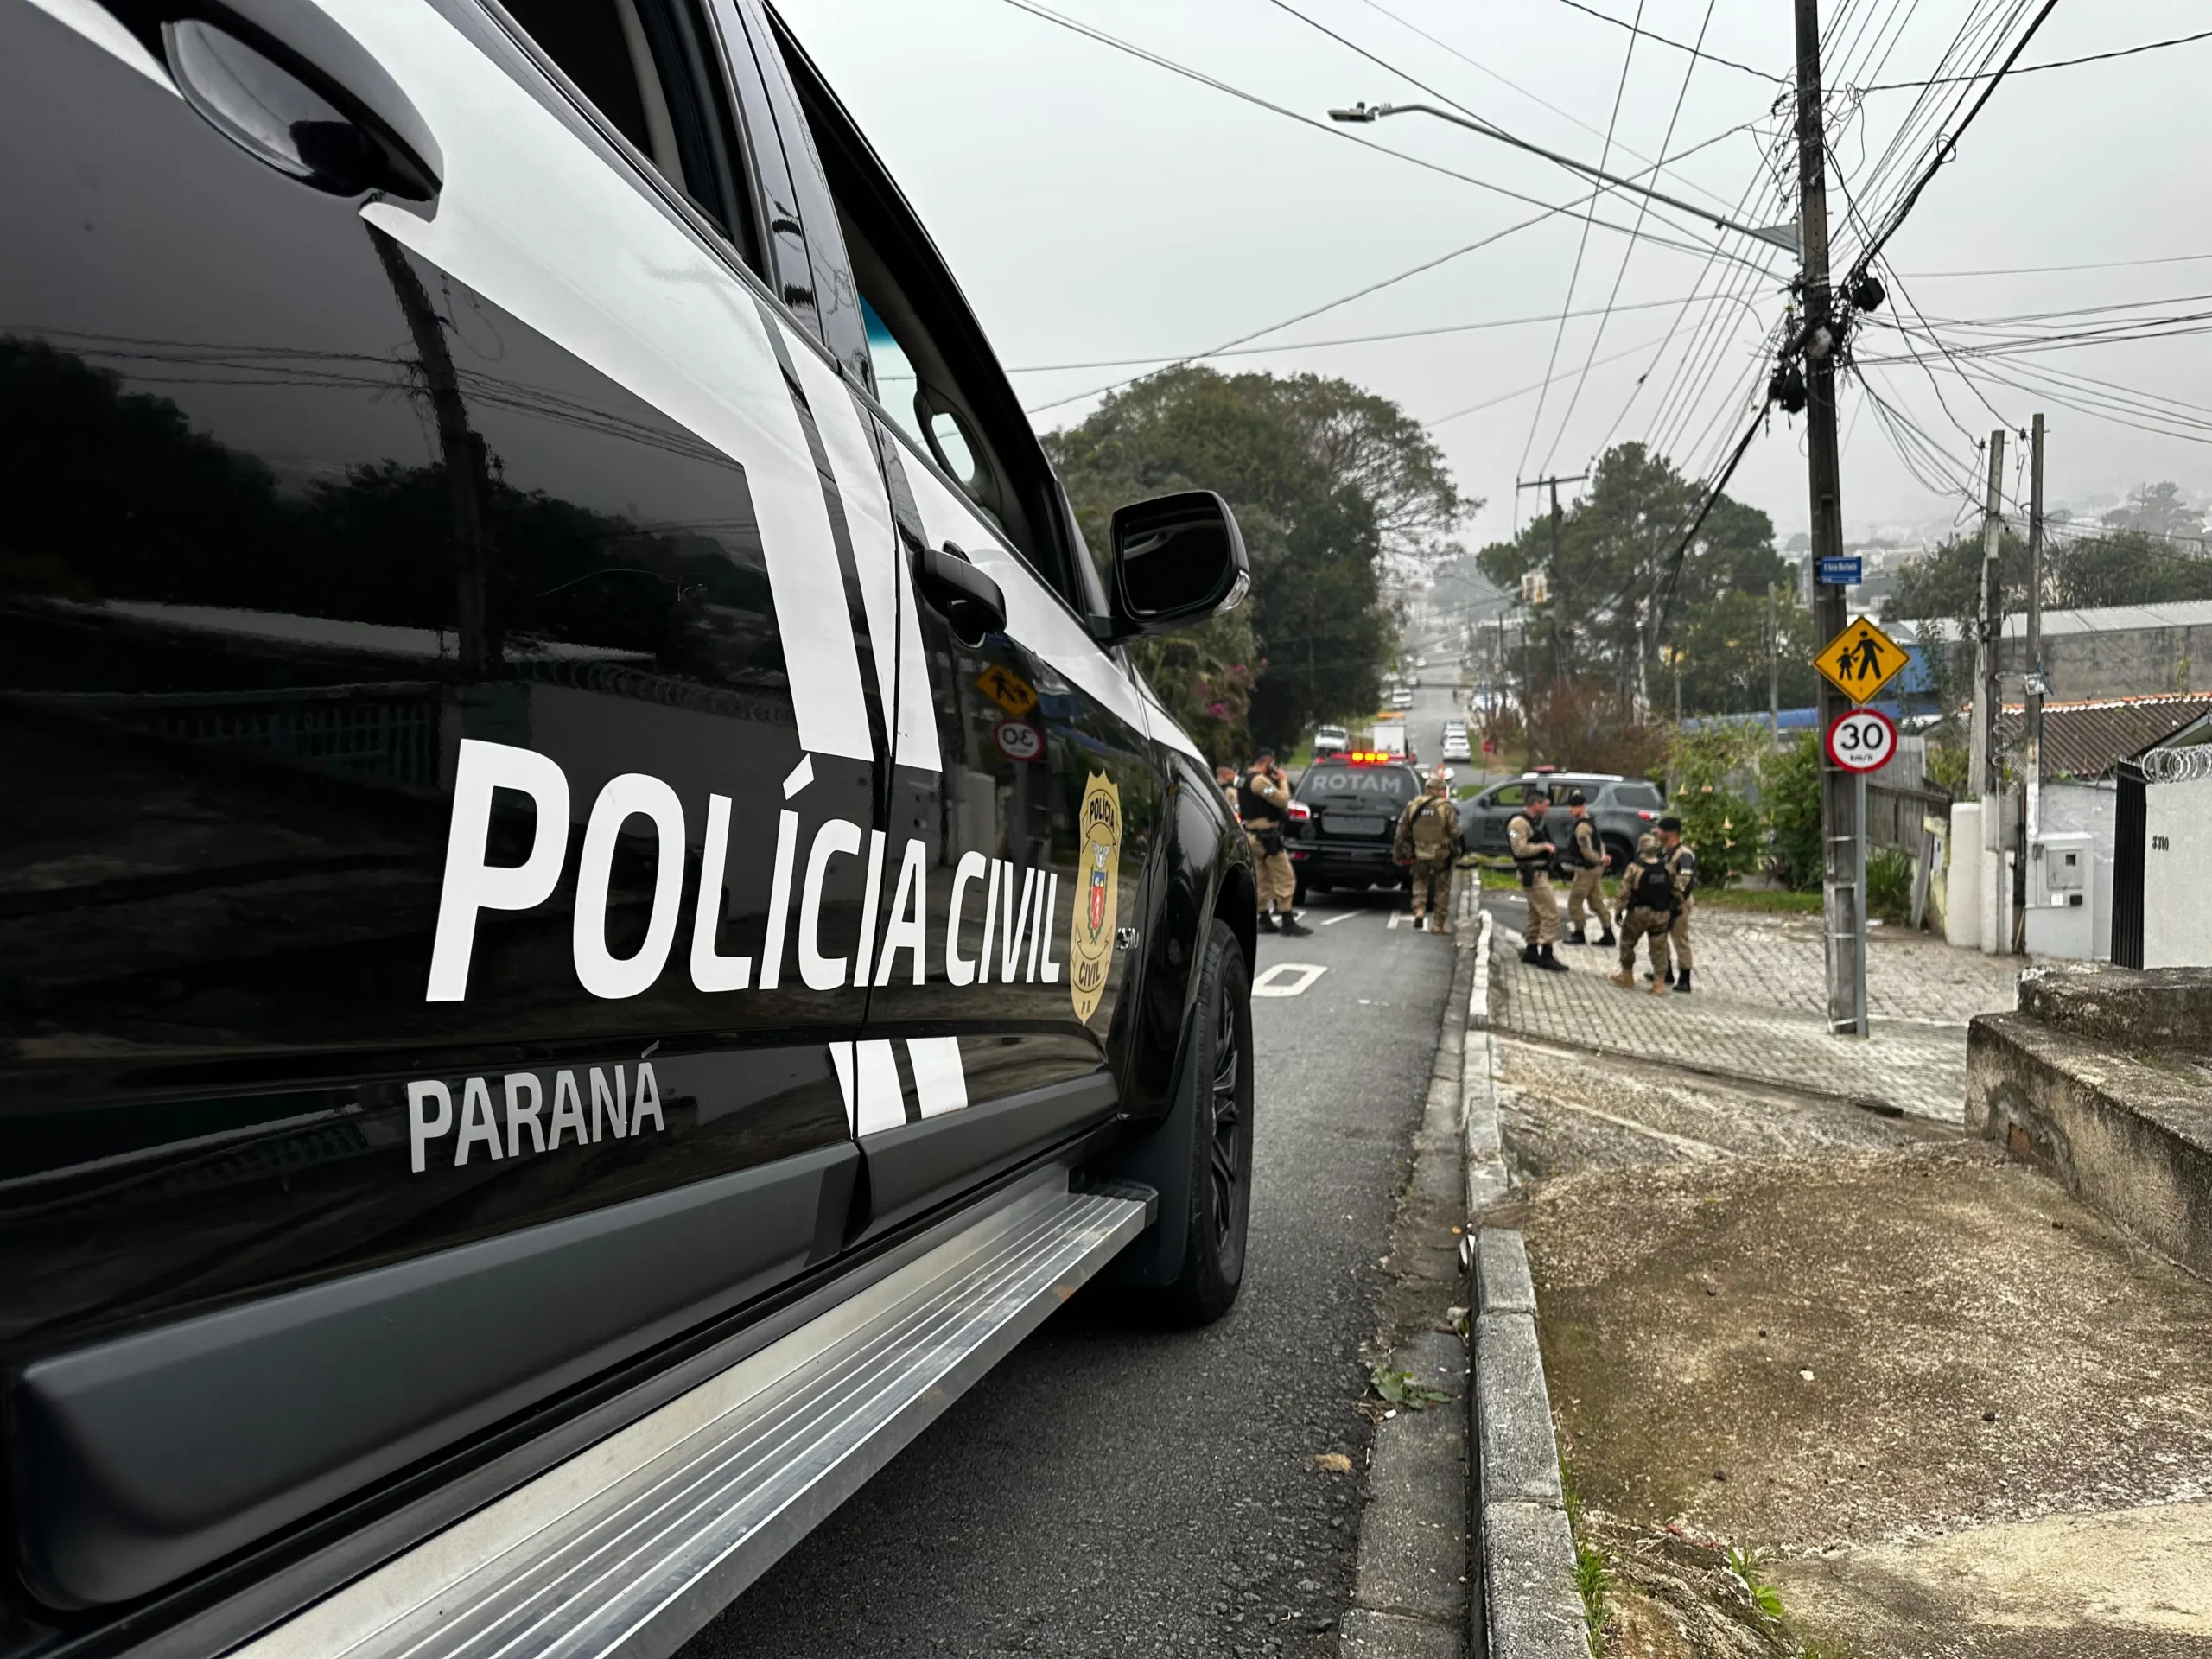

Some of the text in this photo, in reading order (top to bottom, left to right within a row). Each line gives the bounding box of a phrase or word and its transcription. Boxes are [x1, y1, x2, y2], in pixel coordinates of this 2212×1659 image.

[1840, 722, 1883, 750] 30
[1312, 773, 1402, 794] ROTAM
[1089, 793, 1115, 833] POLÍCIA
[425, 738, 1061, 1002] POLÍCIA CIVIL
[1078, 961, 1100, 987] CIVIL
[407, 1039, 664, 1173] PARANÁ
